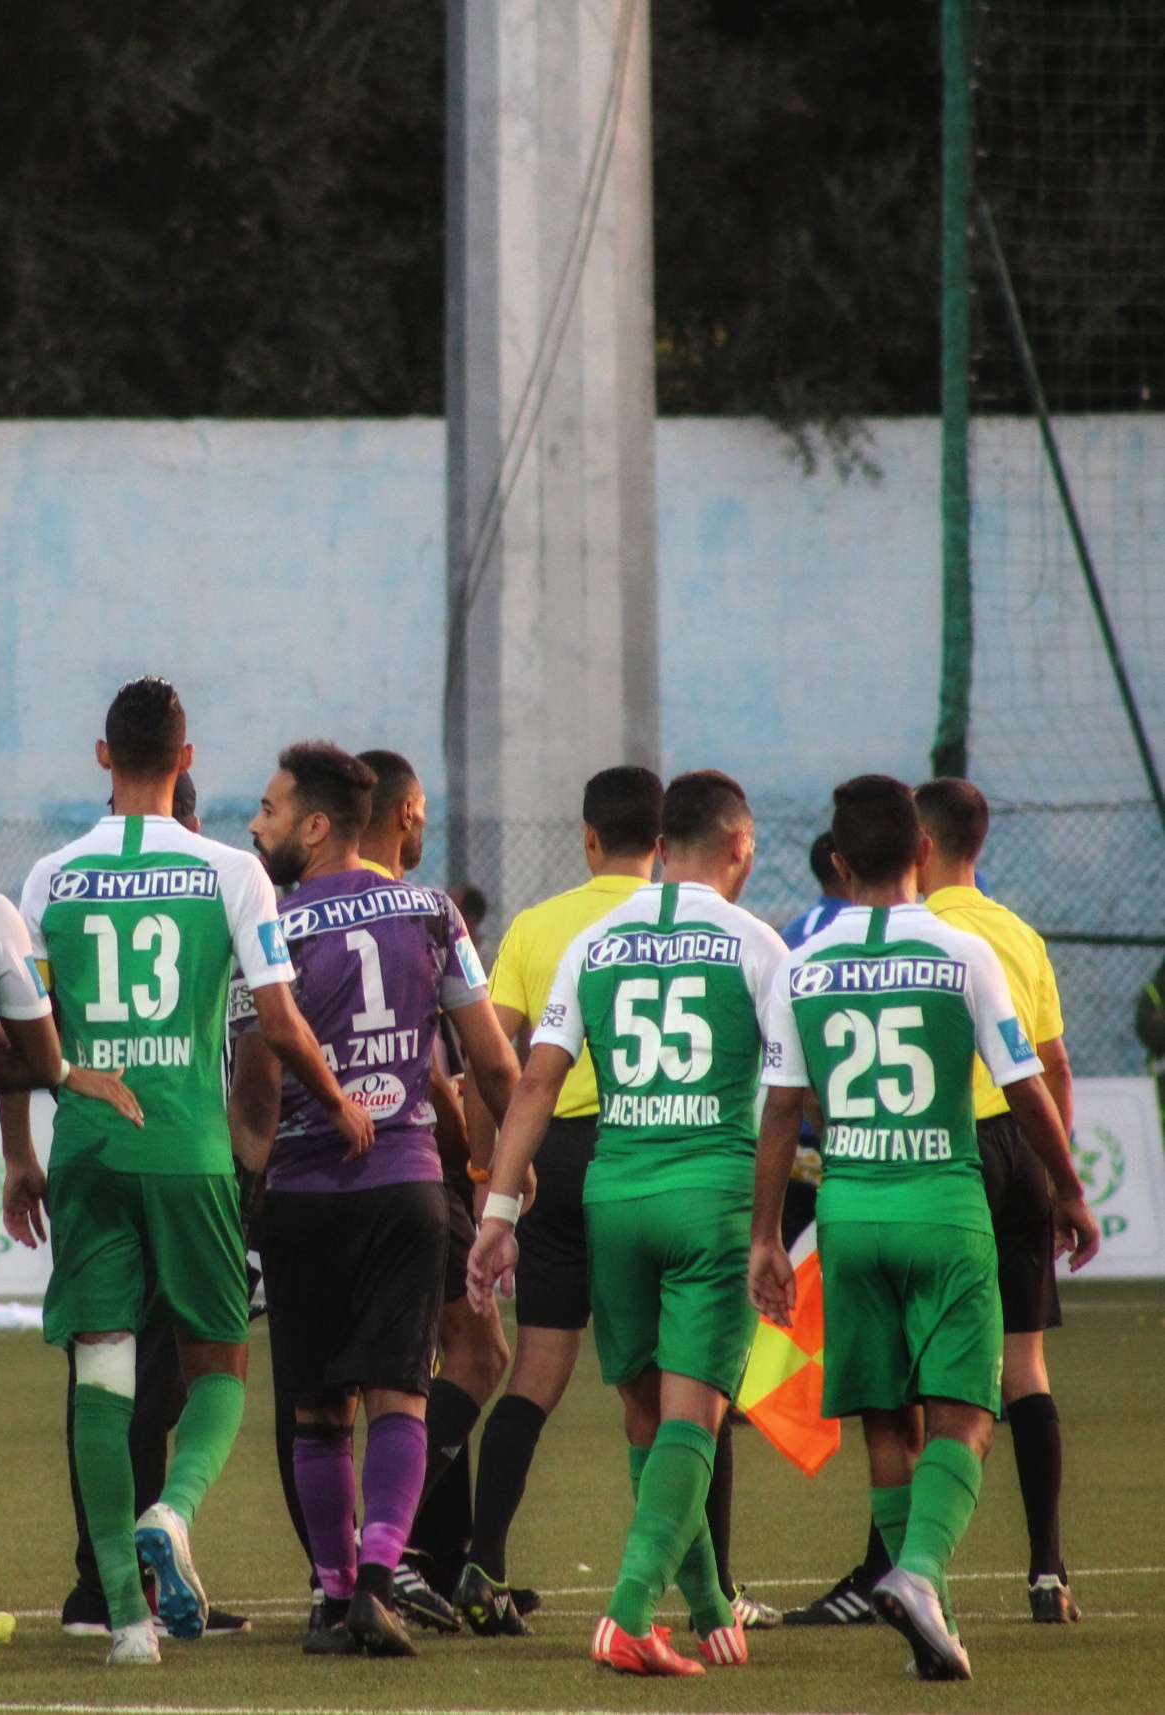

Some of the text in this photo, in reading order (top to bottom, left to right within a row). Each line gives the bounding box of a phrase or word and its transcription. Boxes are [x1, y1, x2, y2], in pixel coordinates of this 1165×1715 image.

[97, 872, 215, 896] HYUNDAI
[324, 889, 436, 925] HYUNDAI
[83, 914, 181, 1022] 13
[636, 936, 739, 961] HYUNDAI
[345, 929, 396, 1032] 1
[841, 962, 965, 988] HYUNDAI
[321, 1029, 419, 1072] A.ZNITI
[612, 976, 713, 1088] 55
[824, 1006, 935, 1118] 25
[362, 1074, 390, 1094] Or
